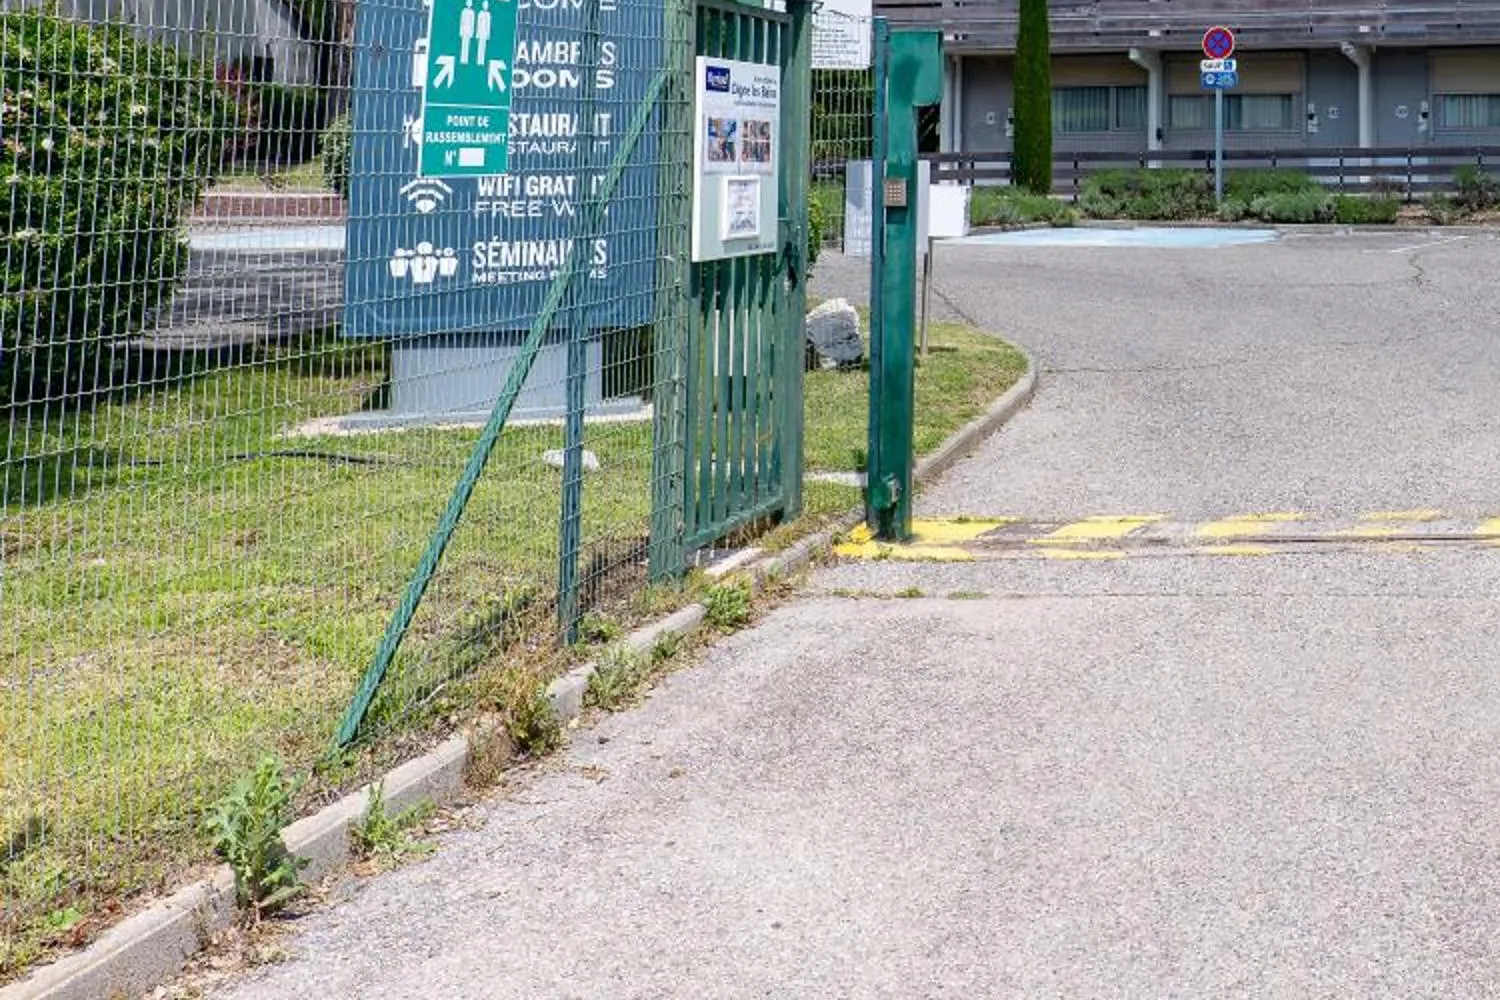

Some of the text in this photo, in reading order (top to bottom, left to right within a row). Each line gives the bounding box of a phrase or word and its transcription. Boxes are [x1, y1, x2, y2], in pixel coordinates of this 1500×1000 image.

[447, 114, 490, 128] POINT DE
[425, 131, 506, 145] RASSEMBLEMENT
[478, 174, 521, 197] WIFI
[475, 200, 543, 218] FREE
